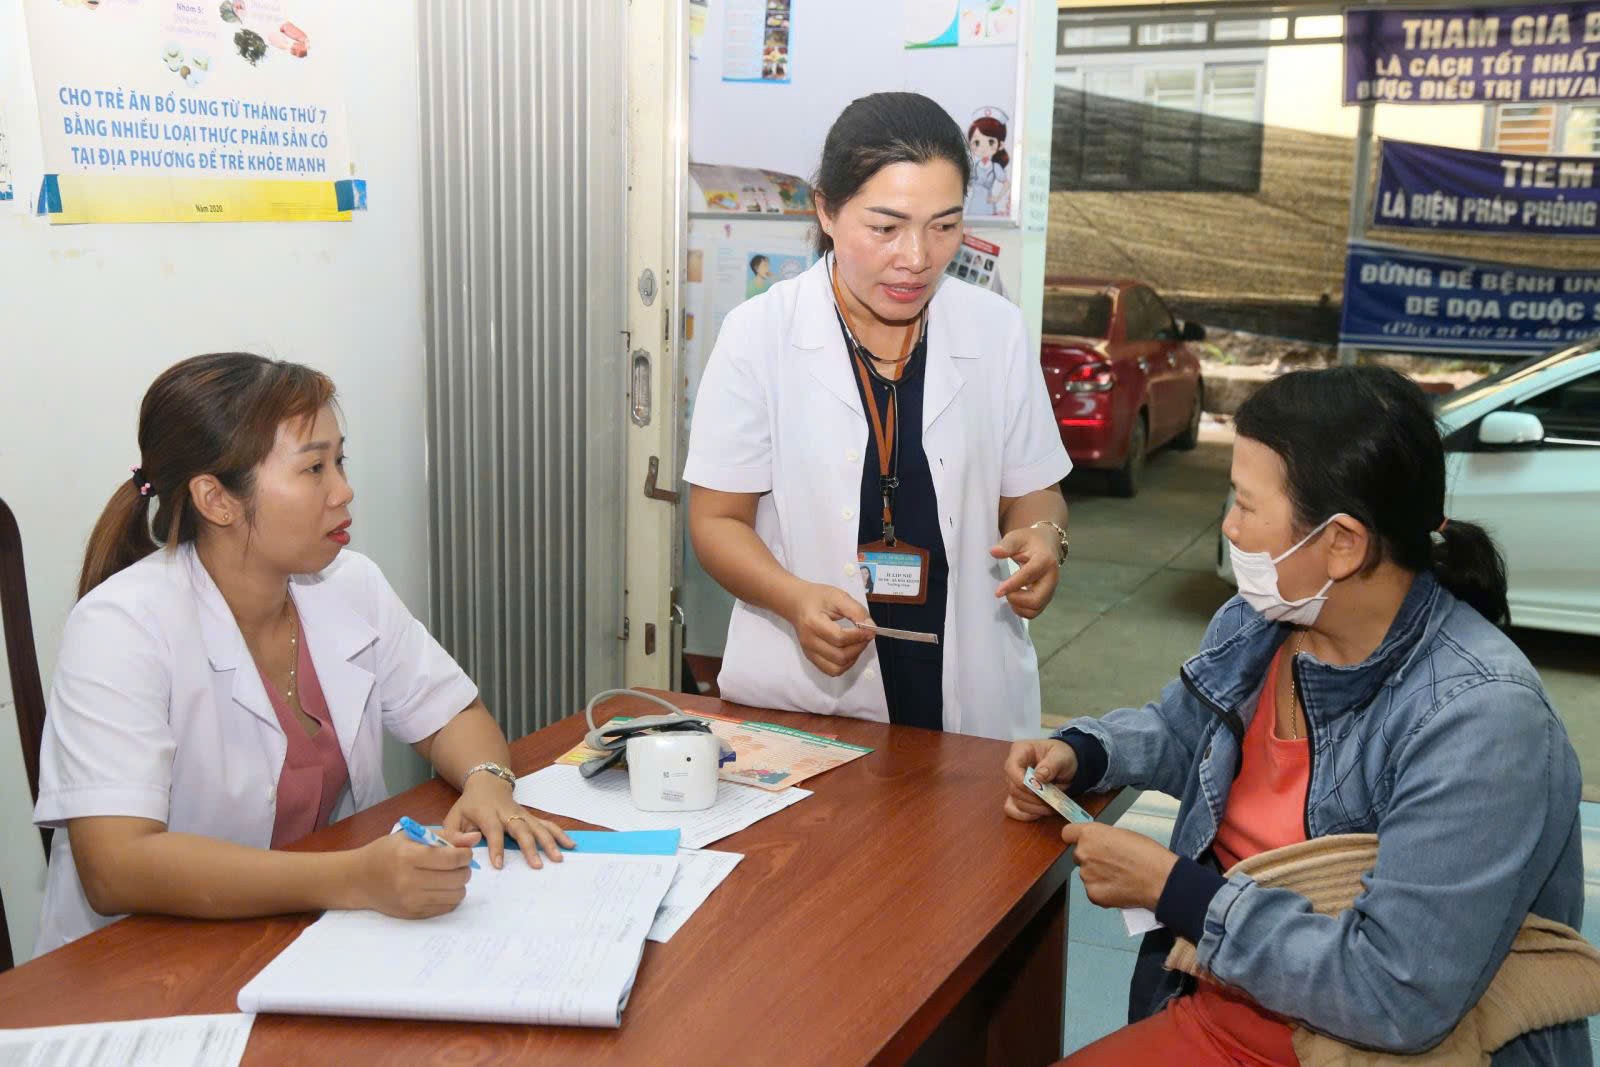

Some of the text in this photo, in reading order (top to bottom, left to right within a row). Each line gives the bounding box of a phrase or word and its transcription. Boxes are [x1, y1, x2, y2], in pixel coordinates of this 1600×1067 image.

[1402, 17, 1500, 49] THAM
[1511, 14, 1571, 47] GIA
[1376, 46, 1600, 77] LÀ CÁCH TỐT NHẤT
[1483, 79, 1522, 102] TRỊ
[1529, 77, 1600, 98] HIV/A
[59, 87, 327, 124] CHO TRẺ ĂN BỔ SUNG TỪ THÁNG THỨ 7
[63, 112, 108, 137] BẰNG
[111, 117, 160, 140] NHIỀU
[163, 123, 197, 146] LOẠI
[199, 126, 238, 149] THỰC
[241, 125, 280, 146] PHẨM
[311, 131, 328, 149] CÓ
[71, 146, 326, 177] TẠI ĐỊA PHƯƠNG ĐỂ TRẺ KHỎE MẠNH
[209, 204, 223, 213] 2020
[1381, 192, 1405, 219] LÀ
[1410, 190, 1457, 226] BIỆN
[1461, 194, 1518, 225] PHÁP
[1481, 270, 1555, 296] BỆNH
[1446, 297, 1501, 322] DỌA
[1508, 296, 1586, 325] CUỘC
